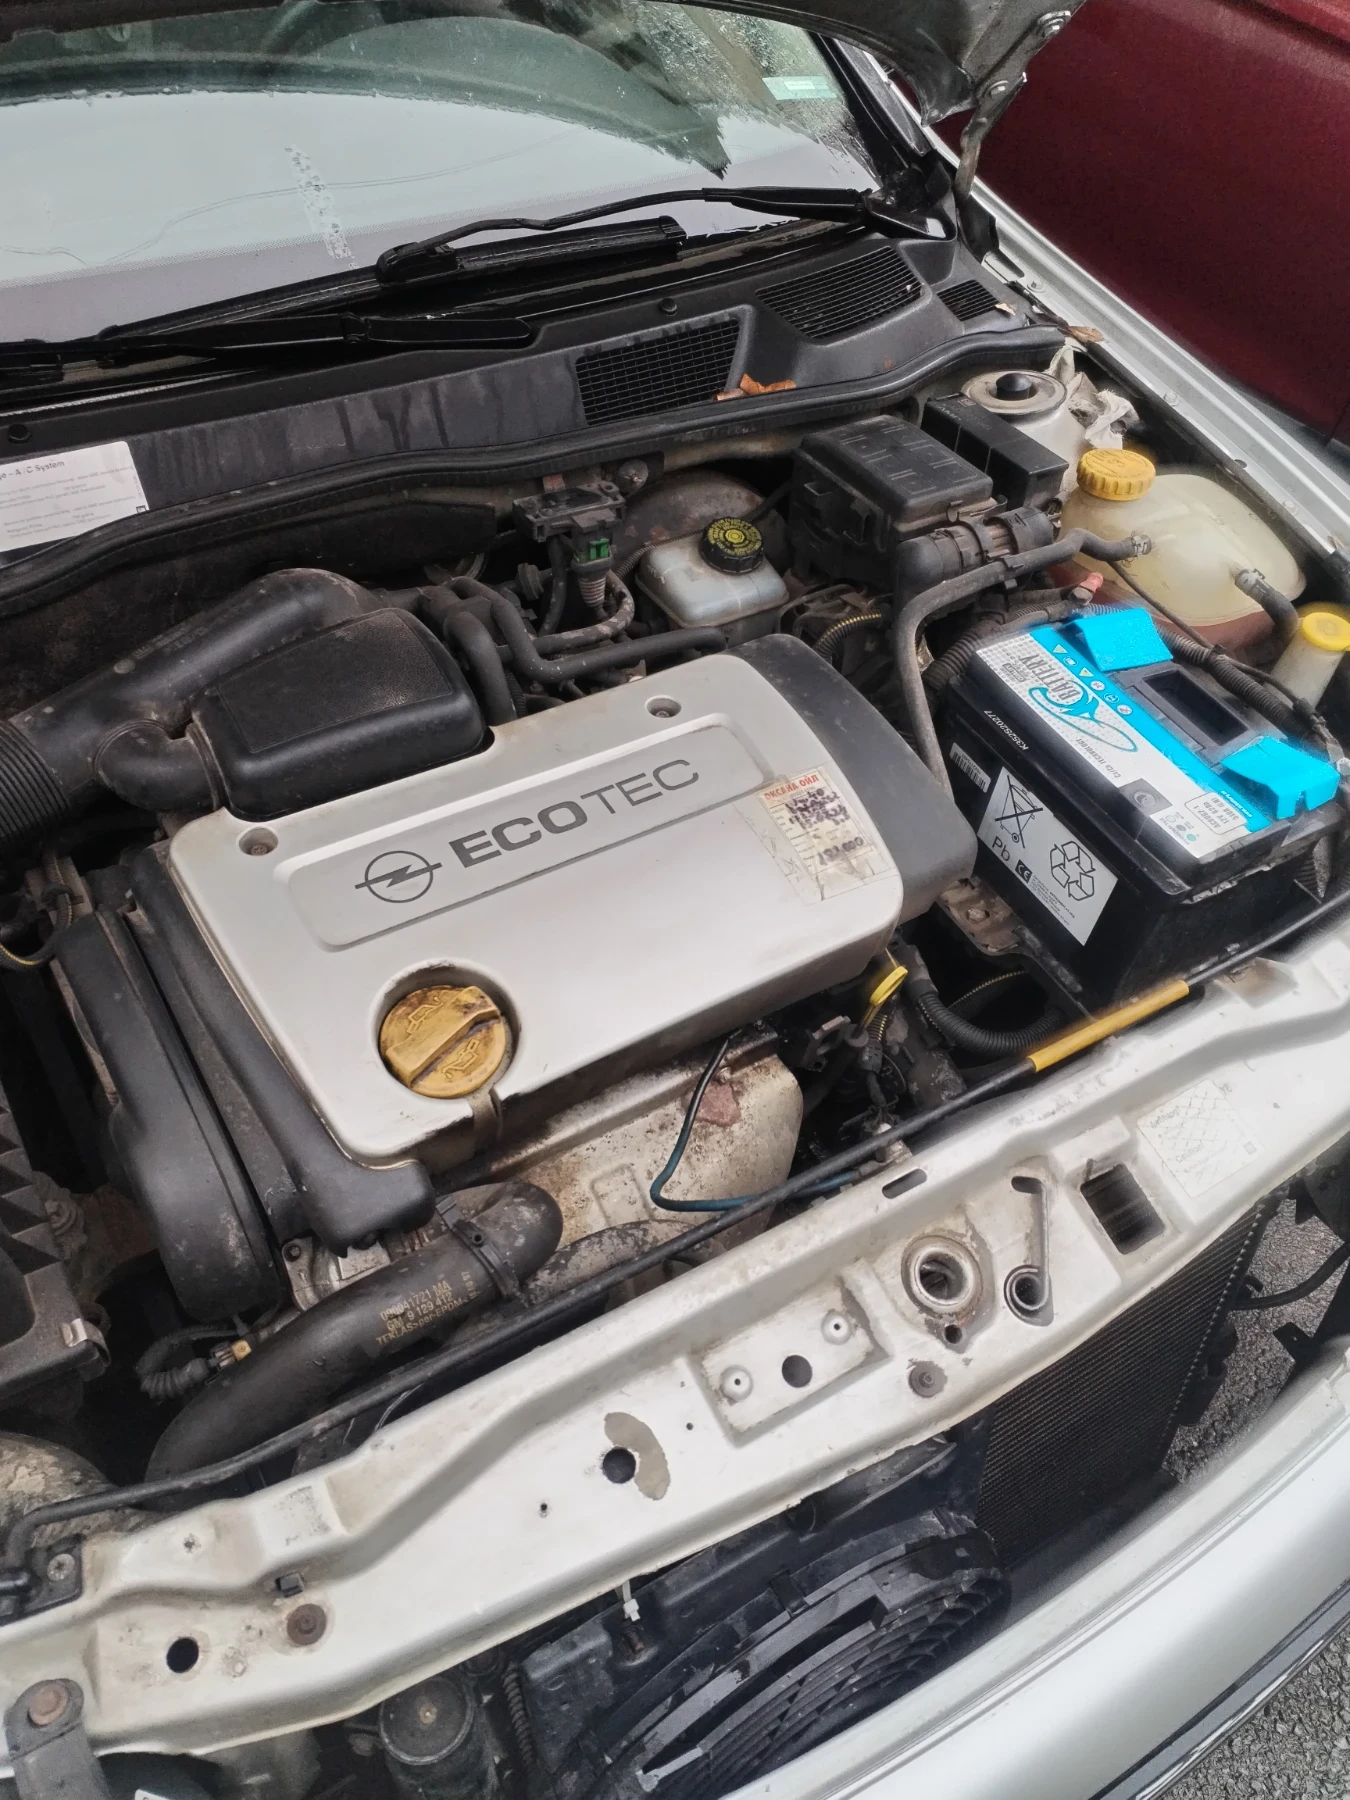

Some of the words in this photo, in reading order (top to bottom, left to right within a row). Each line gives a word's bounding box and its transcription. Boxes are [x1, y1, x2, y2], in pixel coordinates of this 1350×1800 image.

[34, 461, 65, 472] System
[1019, 654, 1081, 701] BATTERY
[764, 782, 799, 801] ОКСАНА
[799, 774, 820, 788] ОЙЛ
[448, 759, 699, 868] ECOTEC
[992, 836, 1010, 862] Pb
[432, 1280, 453, 1297] MA
[386, 1316, 405, 1331] GM
[407, 1310, 415, 1321] 9
[416, 1301, 434, 1316] 129
[436, 1292, 454, 1306] 412
